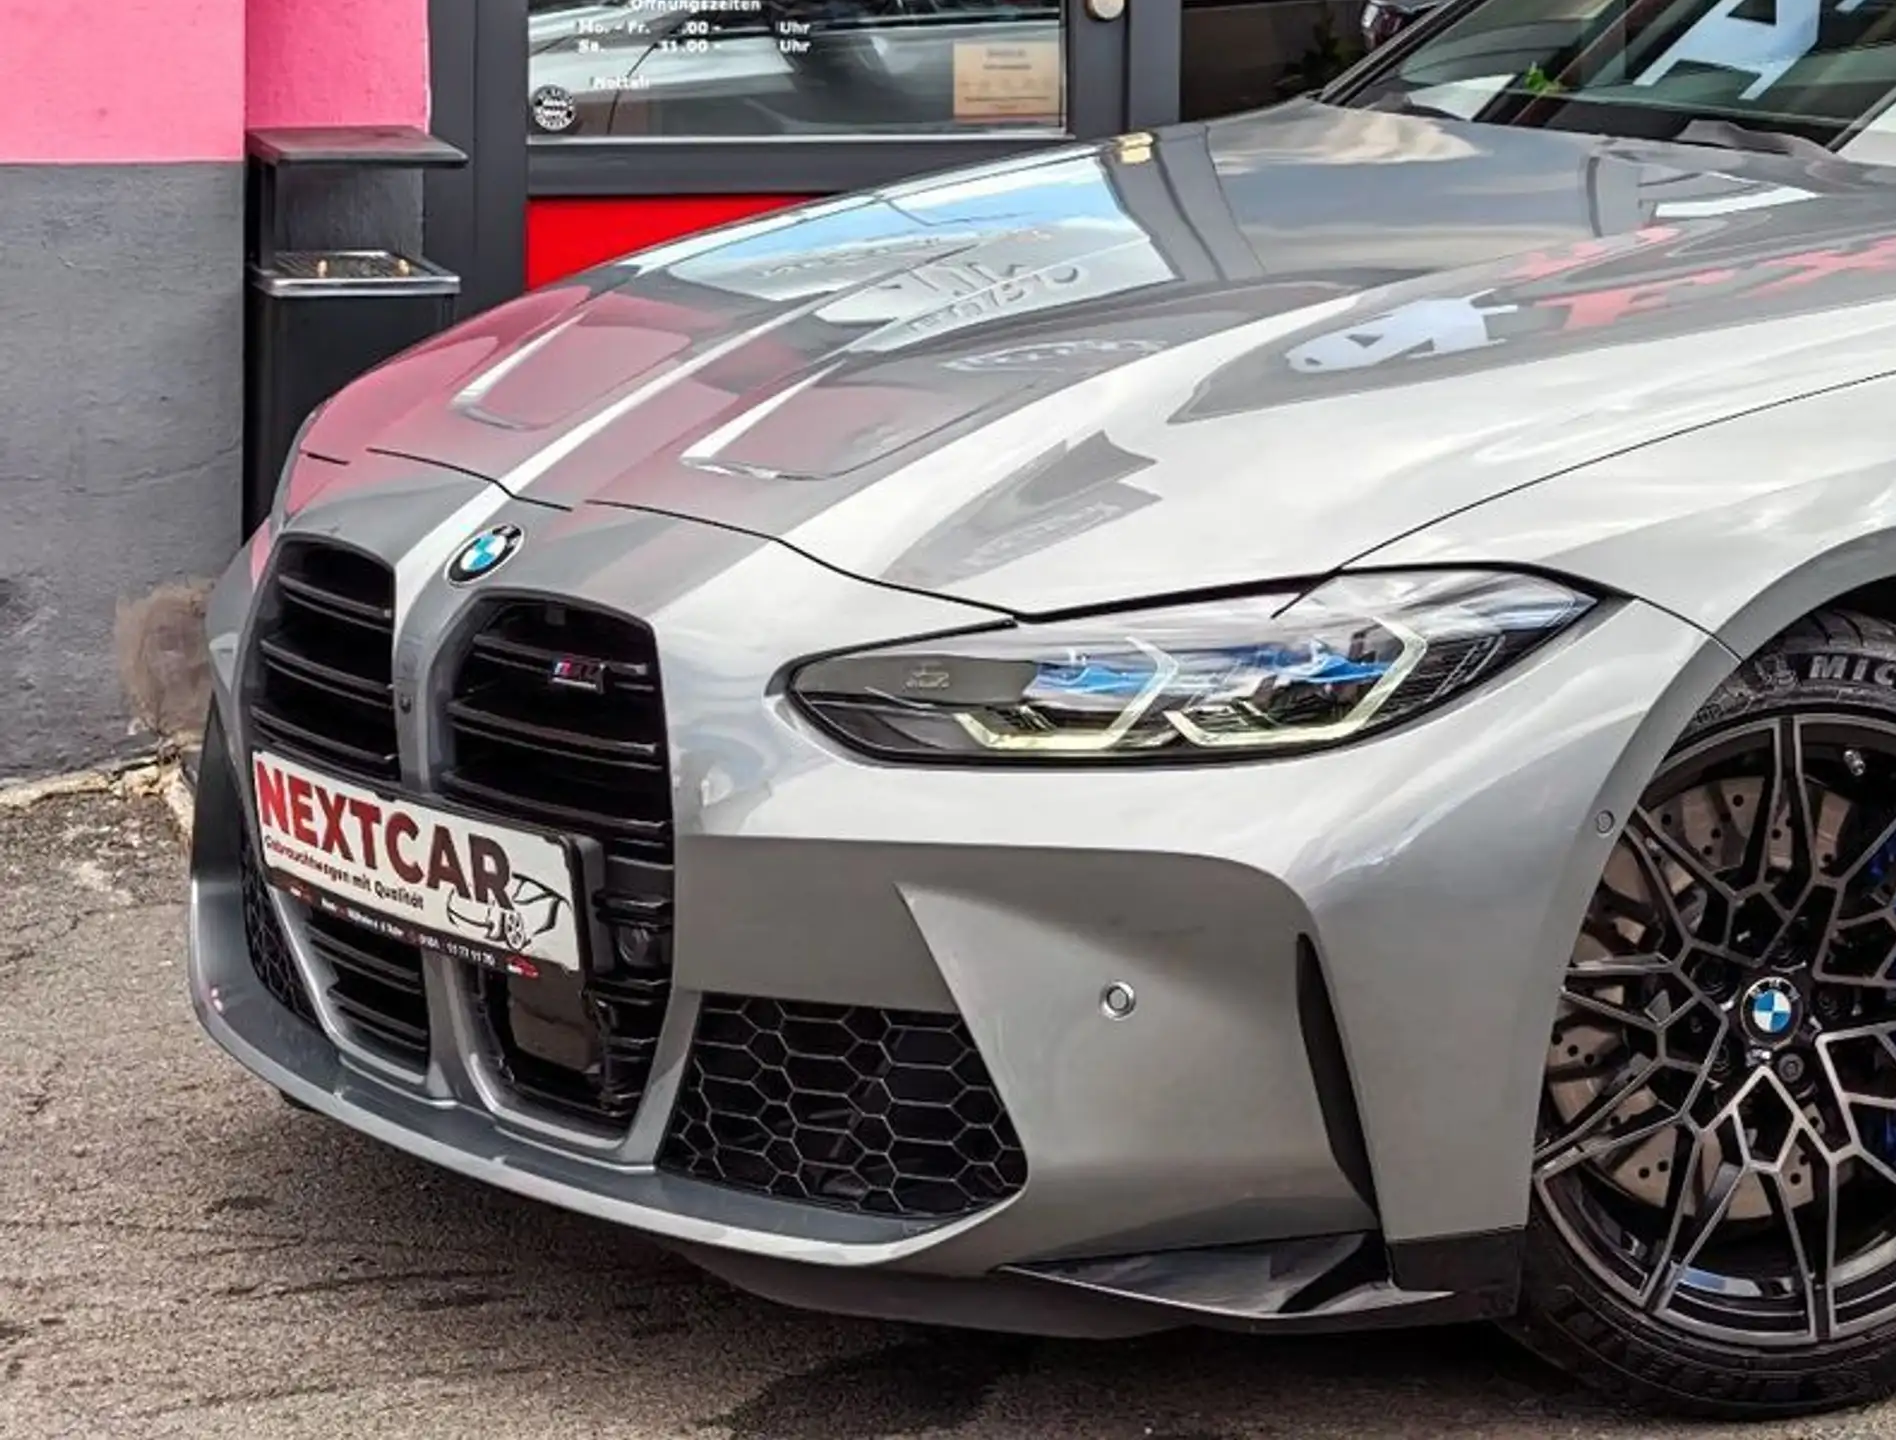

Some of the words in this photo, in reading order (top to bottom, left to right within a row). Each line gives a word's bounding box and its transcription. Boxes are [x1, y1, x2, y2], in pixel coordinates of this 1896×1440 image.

[779, 21, 811, 34] Uhr
[779, 40, 811, 53] Uhr
[256, 760, 515, 910] NEXTCAR
